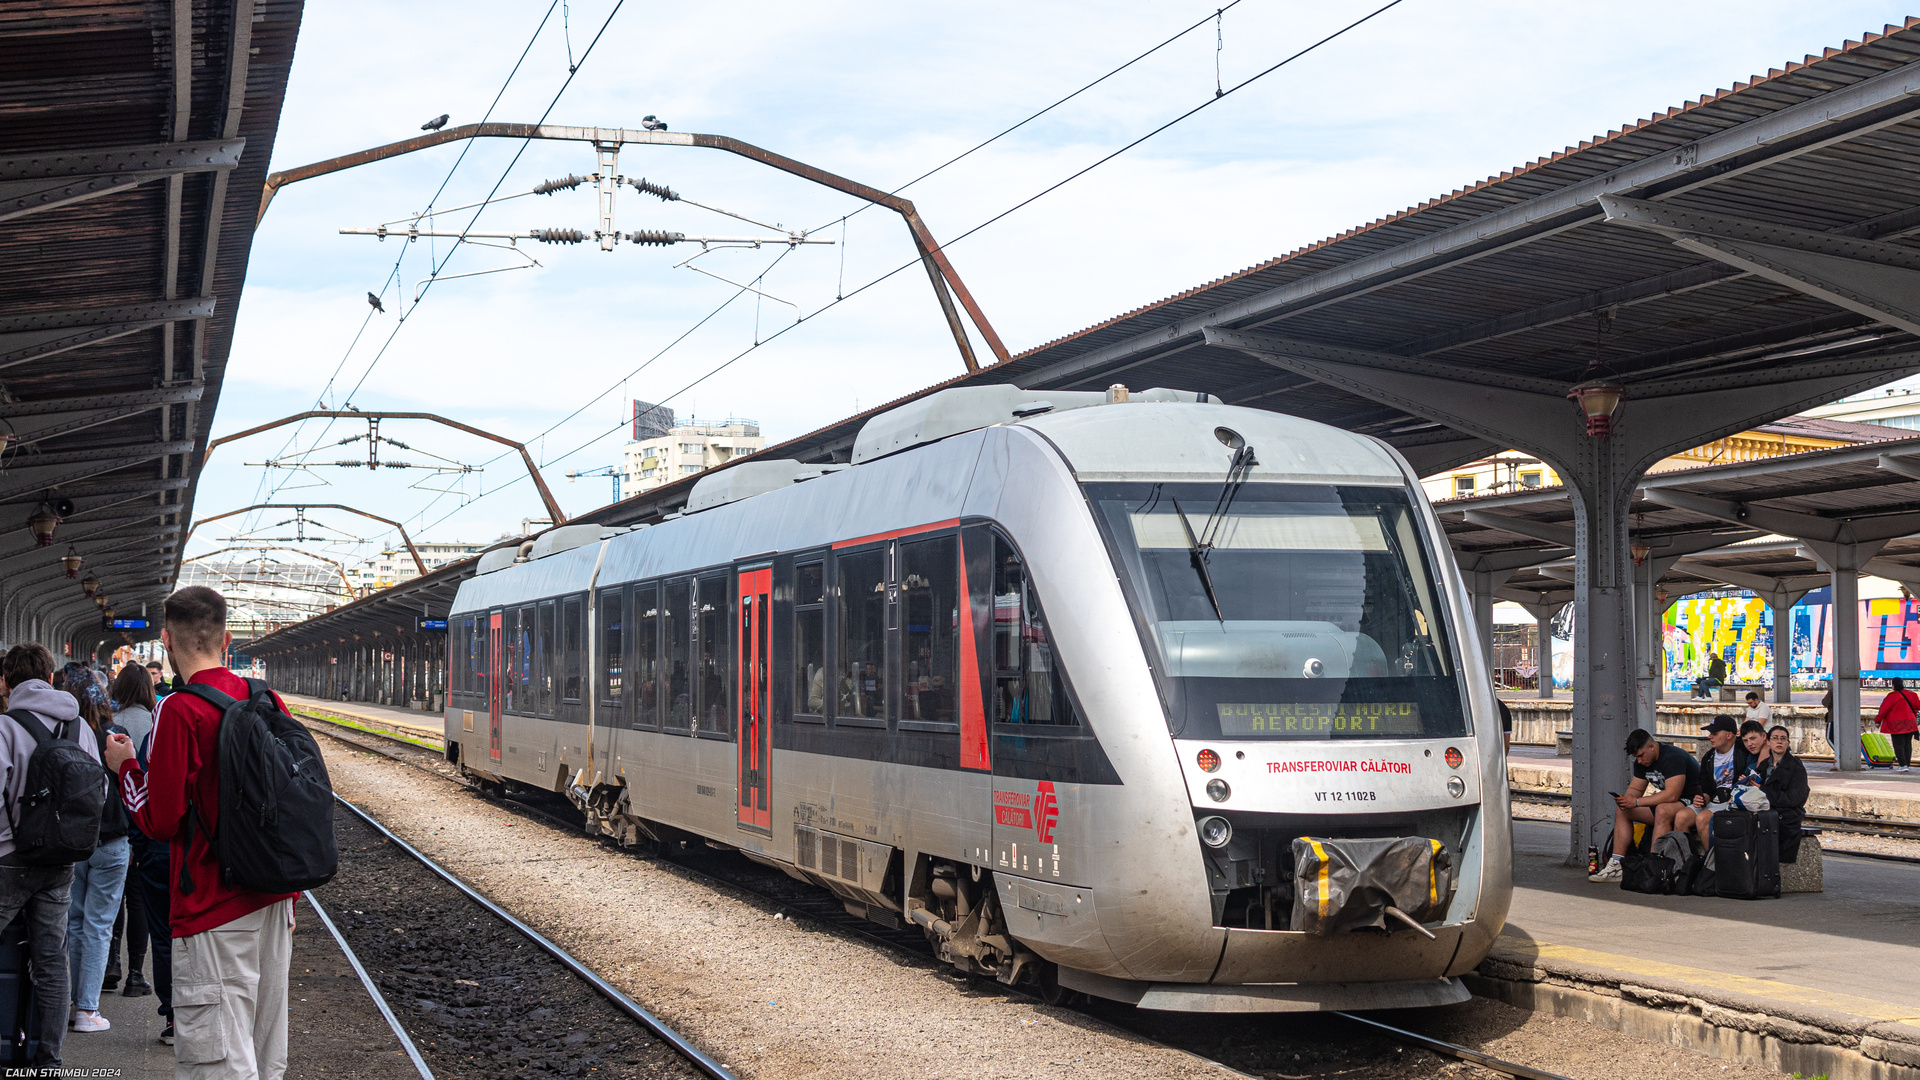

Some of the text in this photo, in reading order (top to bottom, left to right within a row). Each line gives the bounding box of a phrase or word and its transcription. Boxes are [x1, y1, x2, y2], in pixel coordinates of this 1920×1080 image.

[889, 541, 895, 582] 1
[692, 577, 697, 607] 2
[384, 652, 391, 660] C
[1252, 716, 1380, 731] AEROPORT
[1266, 758, 1412, 775] TRANSFEROVIAR CĂLĂTORI
[993, 789, 1031, 808] TRANSFEROVIAR
[1315, 791, 1328, 802] VT
[1331, 791, 1343, 802] 12
